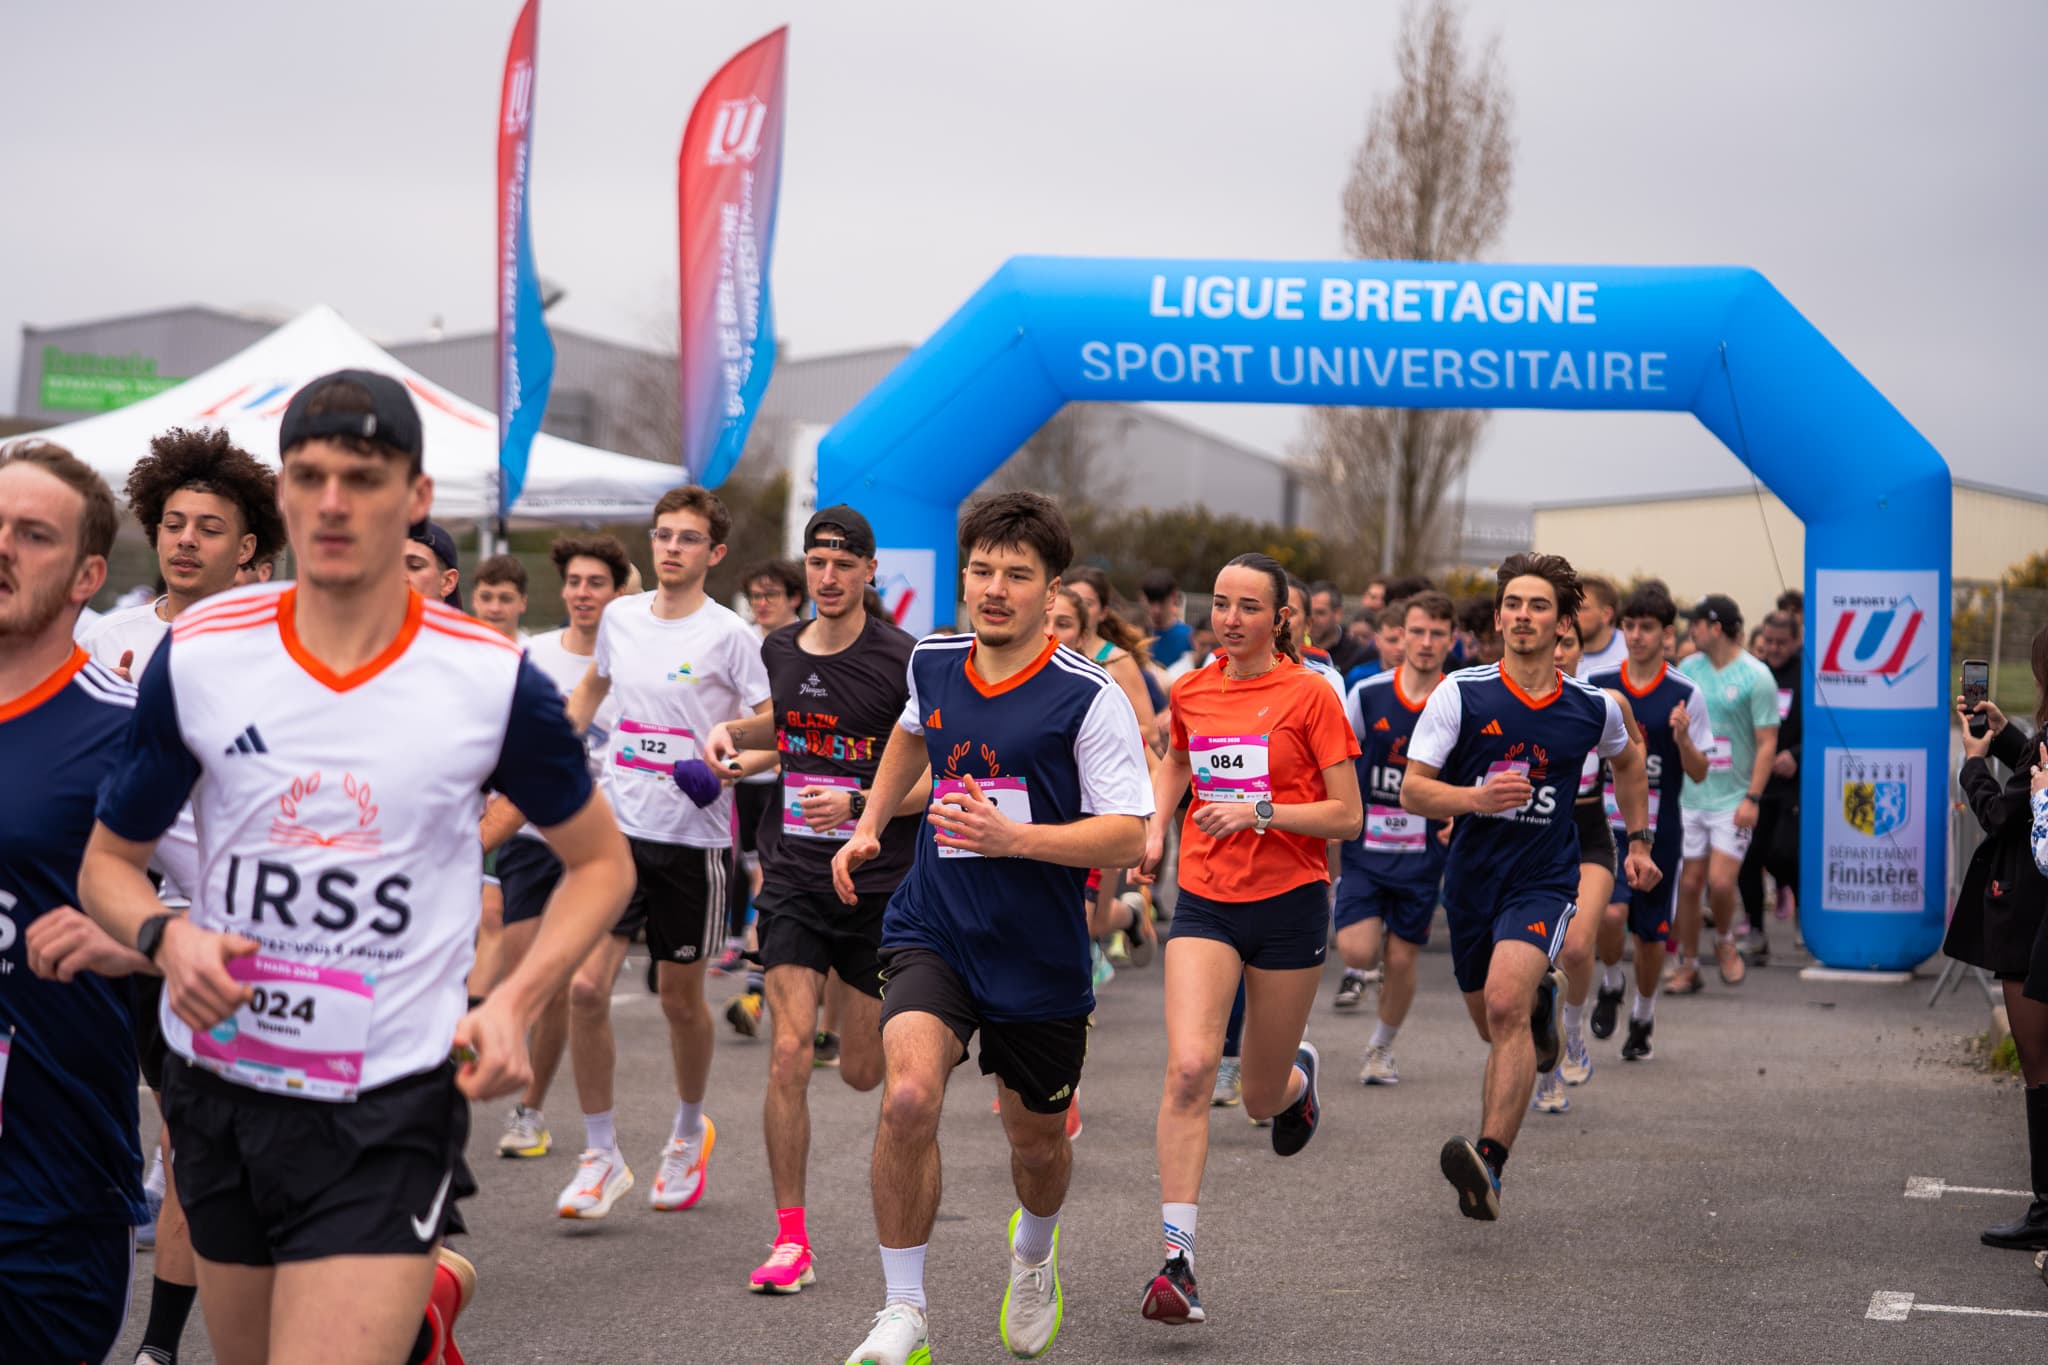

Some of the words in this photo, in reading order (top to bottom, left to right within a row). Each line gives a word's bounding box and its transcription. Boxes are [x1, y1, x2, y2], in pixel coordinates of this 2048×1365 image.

[1150, 275, 1306, 321] LIGUE
[1318, 277, 1598, 325] BRETAGNE
[1081, 341, 1254, 384] SPORT
[1270, 346, 1668, 392] UNIVERSITAIRE
[641, 739, 667, 754] 122
[1211, 755, 1244, 769] 084
[1829, 862, 1919, 885] Finistère
[225, 854, 413, 938] IRSS
[250, 987, 316, 1023] 024
